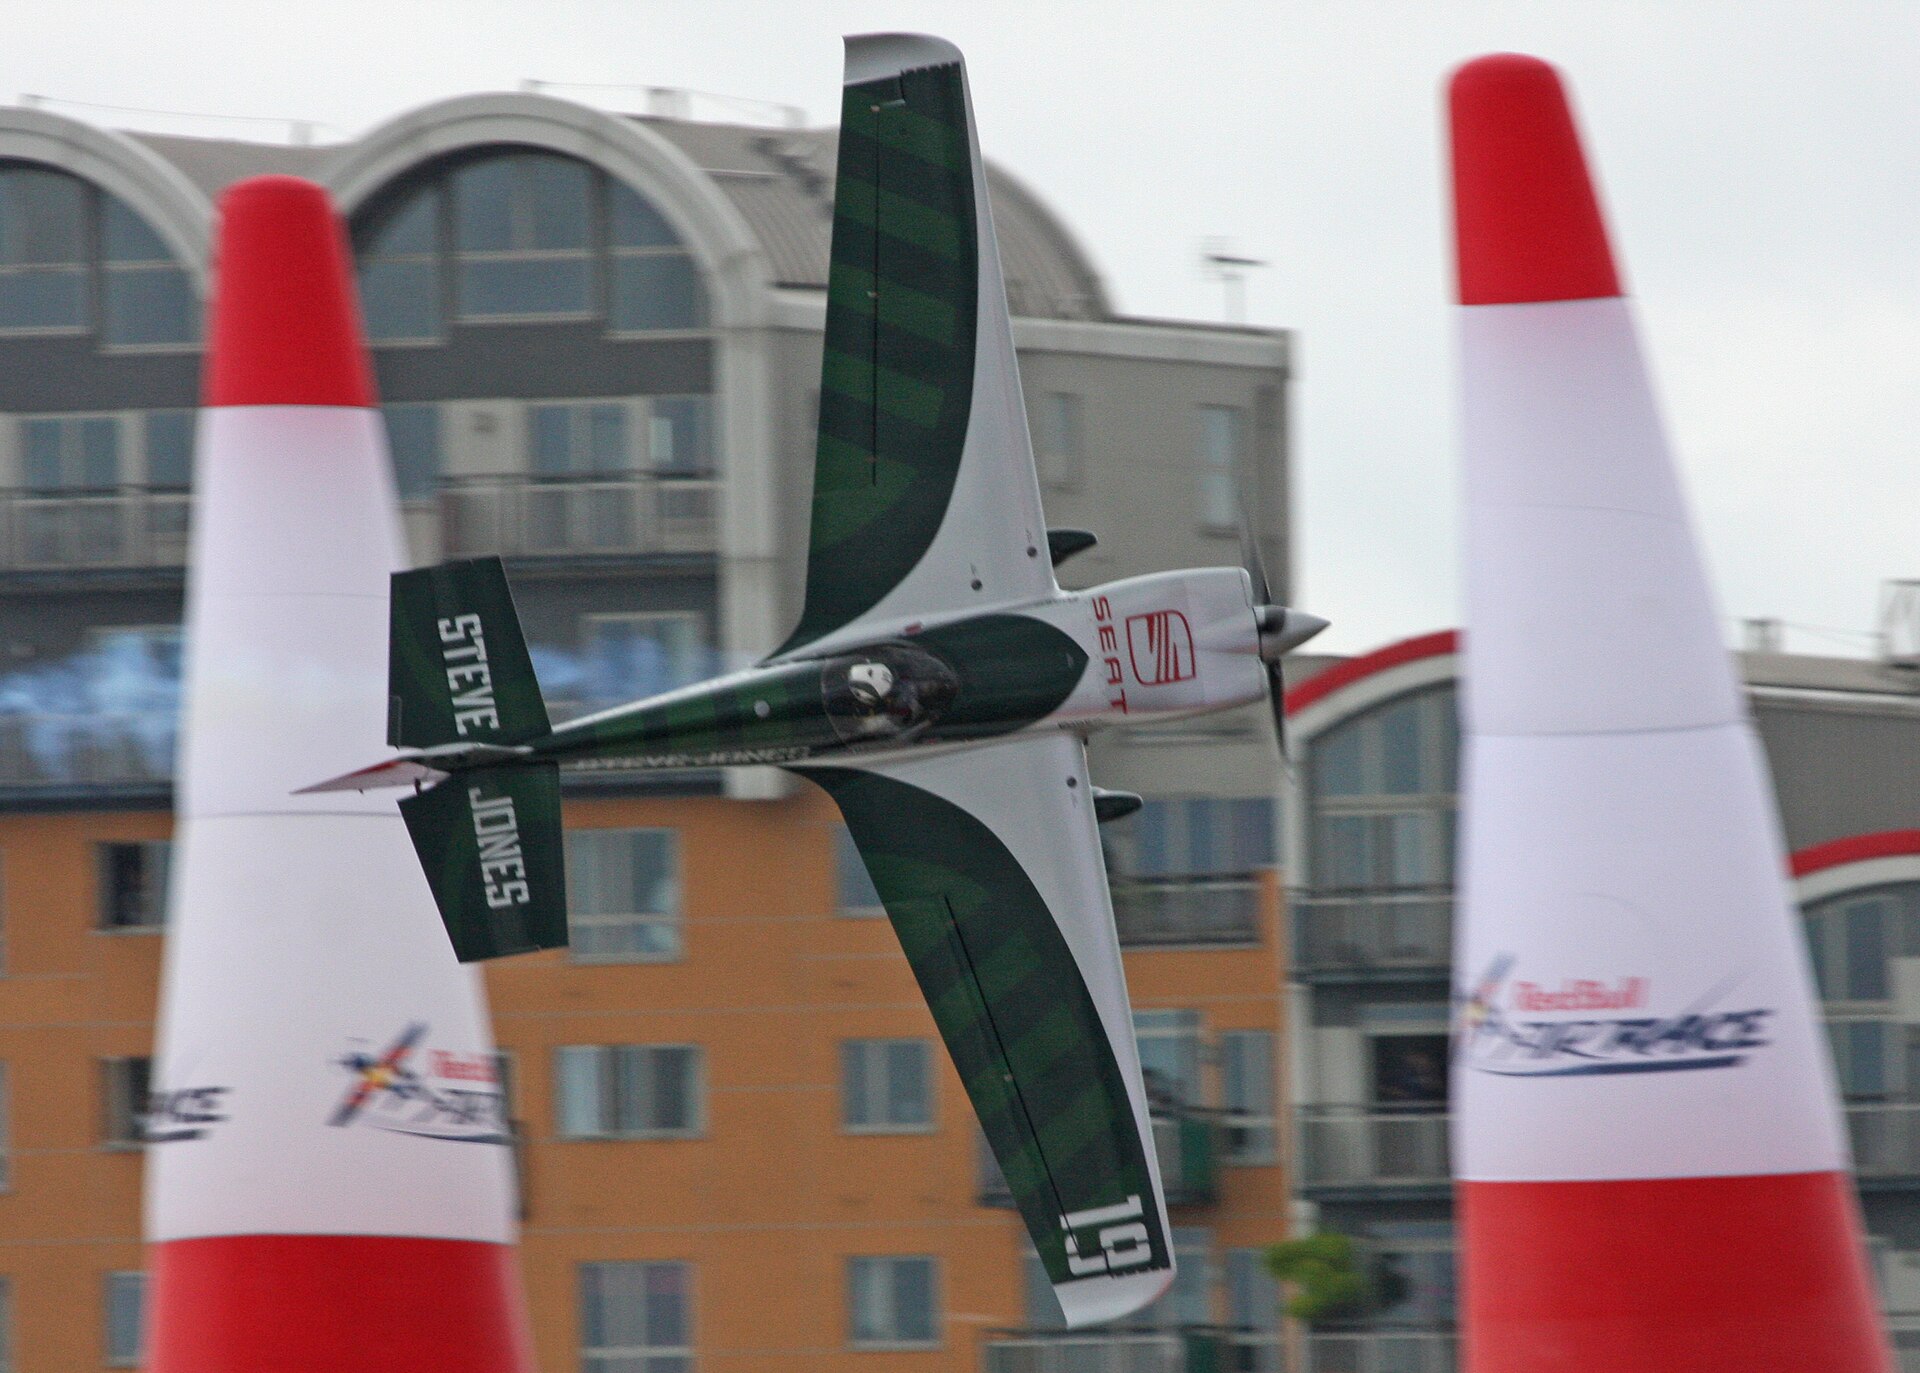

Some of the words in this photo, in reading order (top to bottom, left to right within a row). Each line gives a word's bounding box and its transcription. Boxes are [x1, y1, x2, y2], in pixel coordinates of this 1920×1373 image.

[437, 612, 501, 737] STEVE
[1092, 595, 1129, 715] SEAT
[467, 781, 531, 910] JONES
[1059, 1194, 1153, 1277] 19
